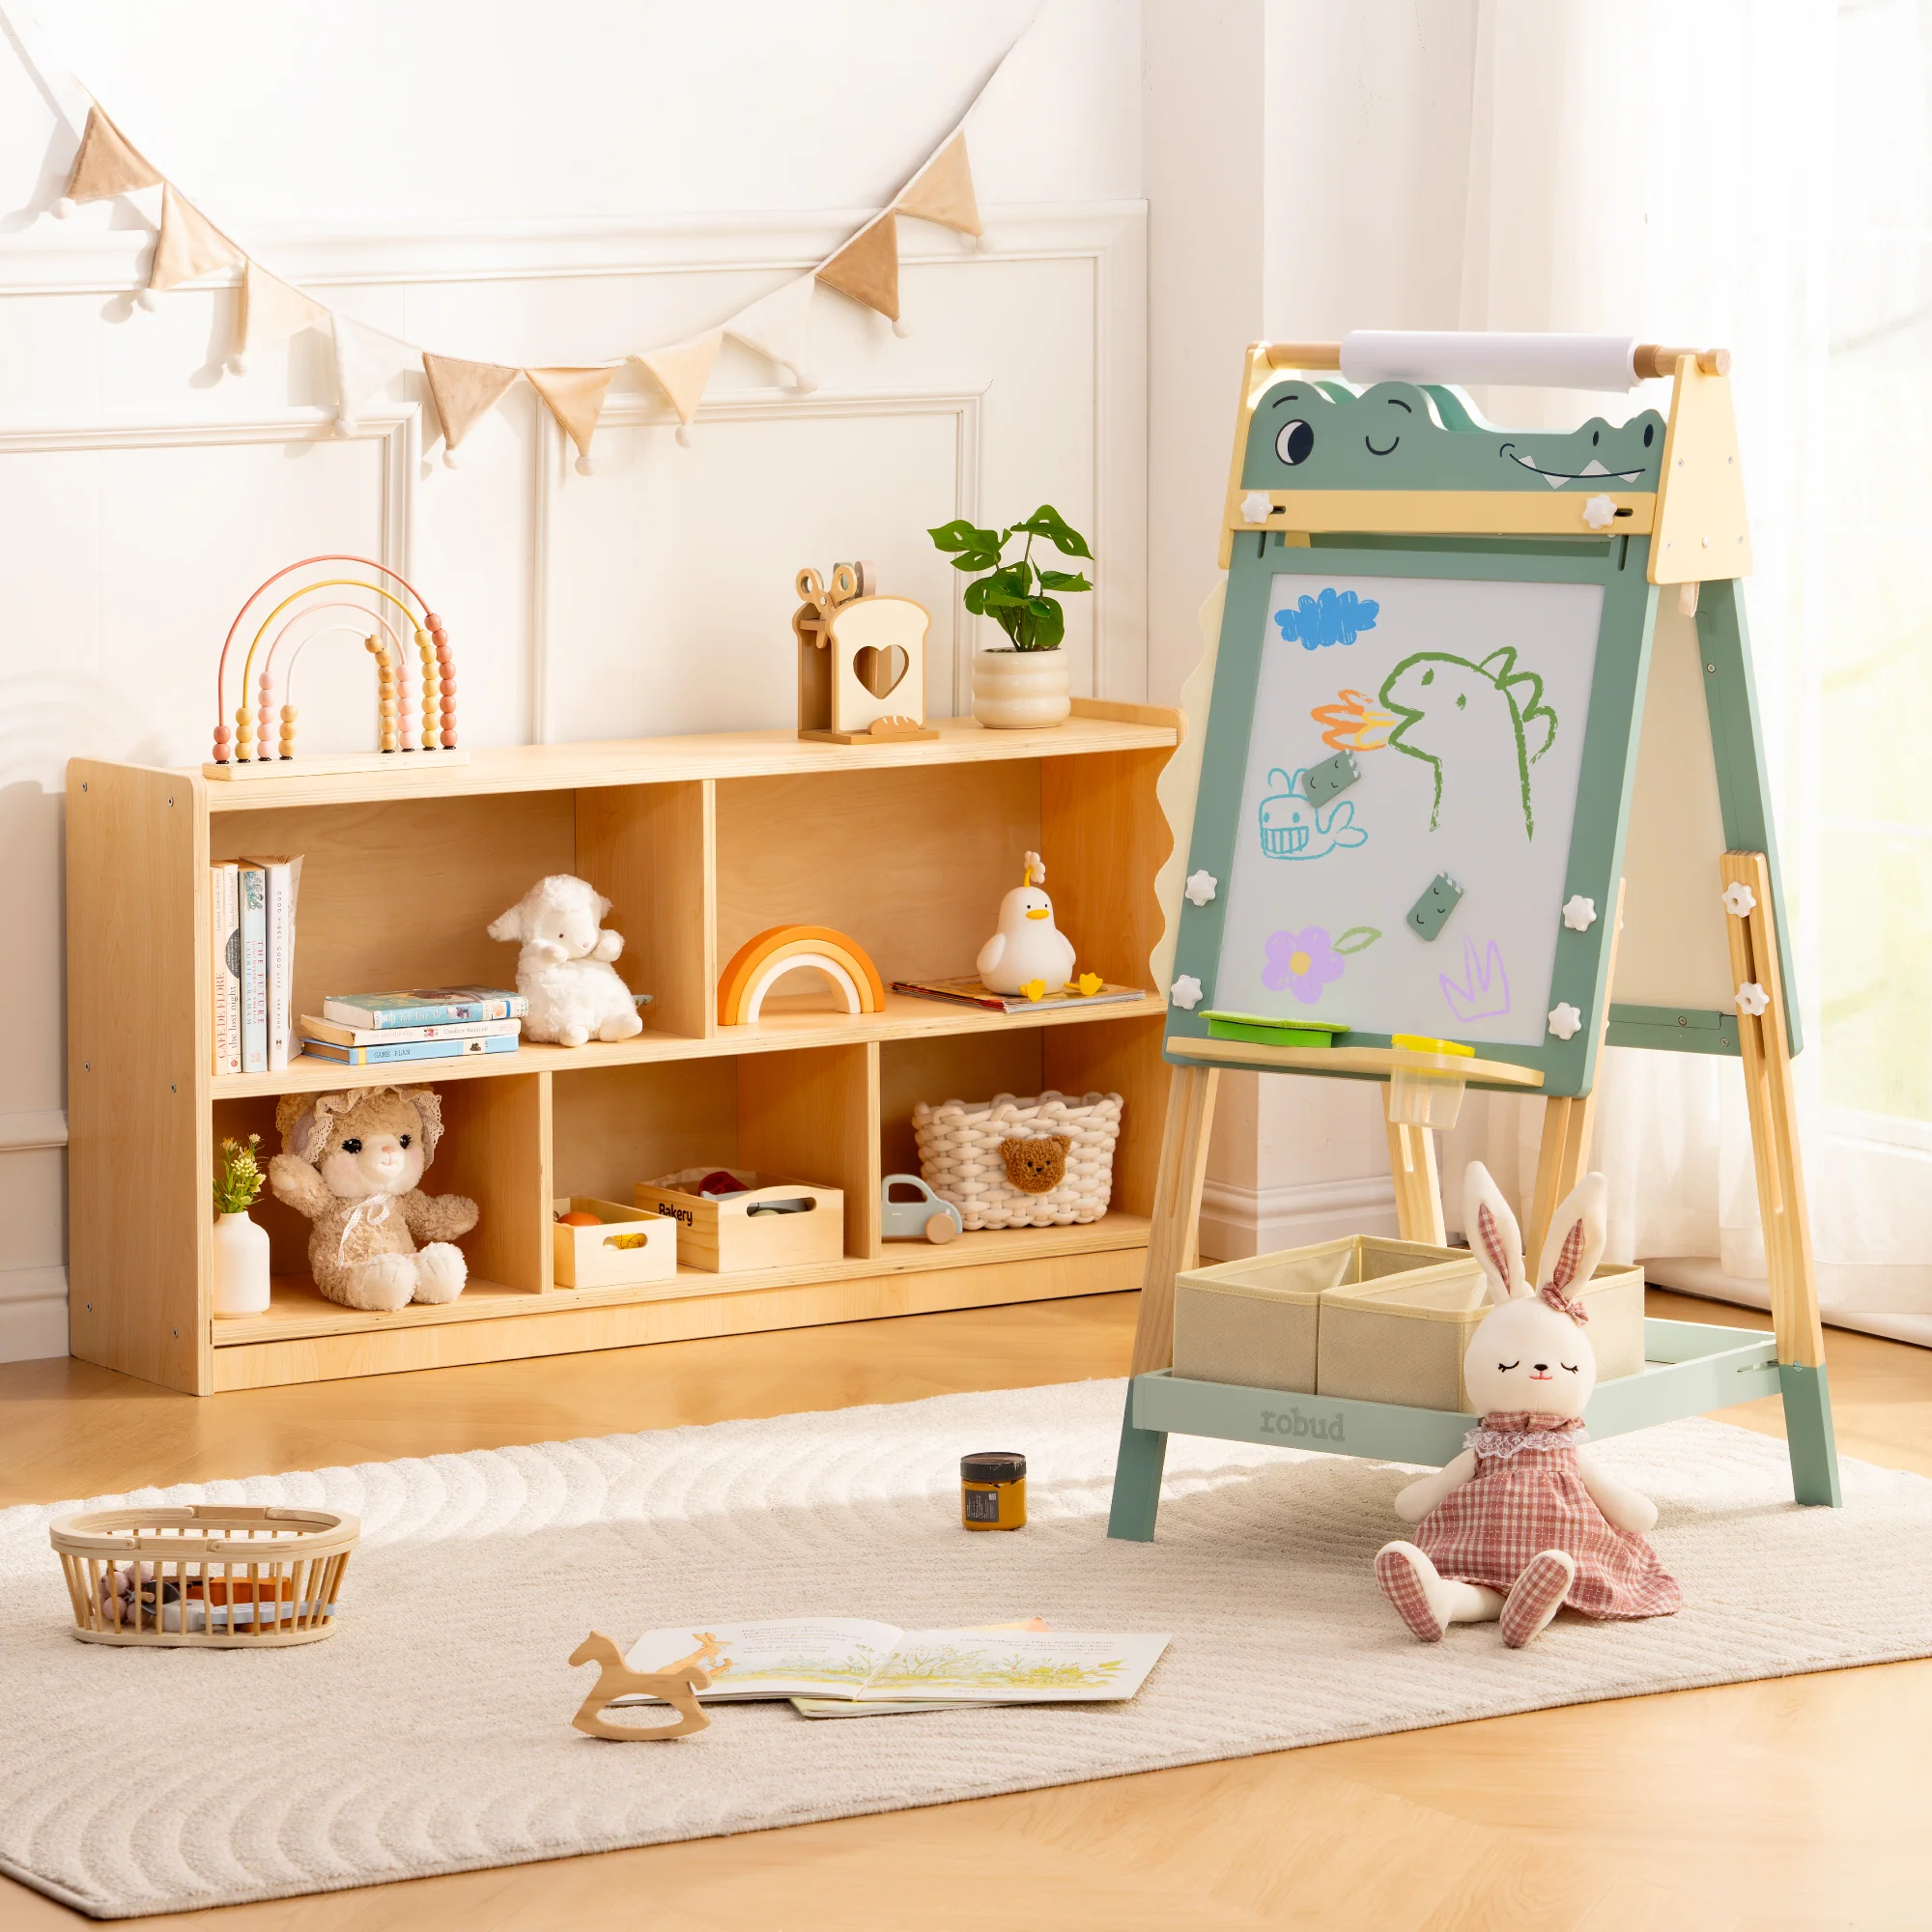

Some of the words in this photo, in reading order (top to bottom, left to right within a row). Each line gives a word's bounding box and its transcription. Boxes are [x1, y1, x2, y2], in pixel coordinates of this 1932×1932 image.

[215, 972, 225, 1009] FLORE
[228, 986, 239, 1011] night
[216, 1010, 225, 1026] DE
[228, 1014, 237, 1031] lost
[216, 1029, 226, 1059] CAFE
[228, 1034, 237, 1049] the
[373, 1050, 390, 1059] GAME
[394, 1049, 411, 1058] PLAN
[659, 1203, 693, 1227] Bakery
[1260, 1406, 1347, 1442] robud
